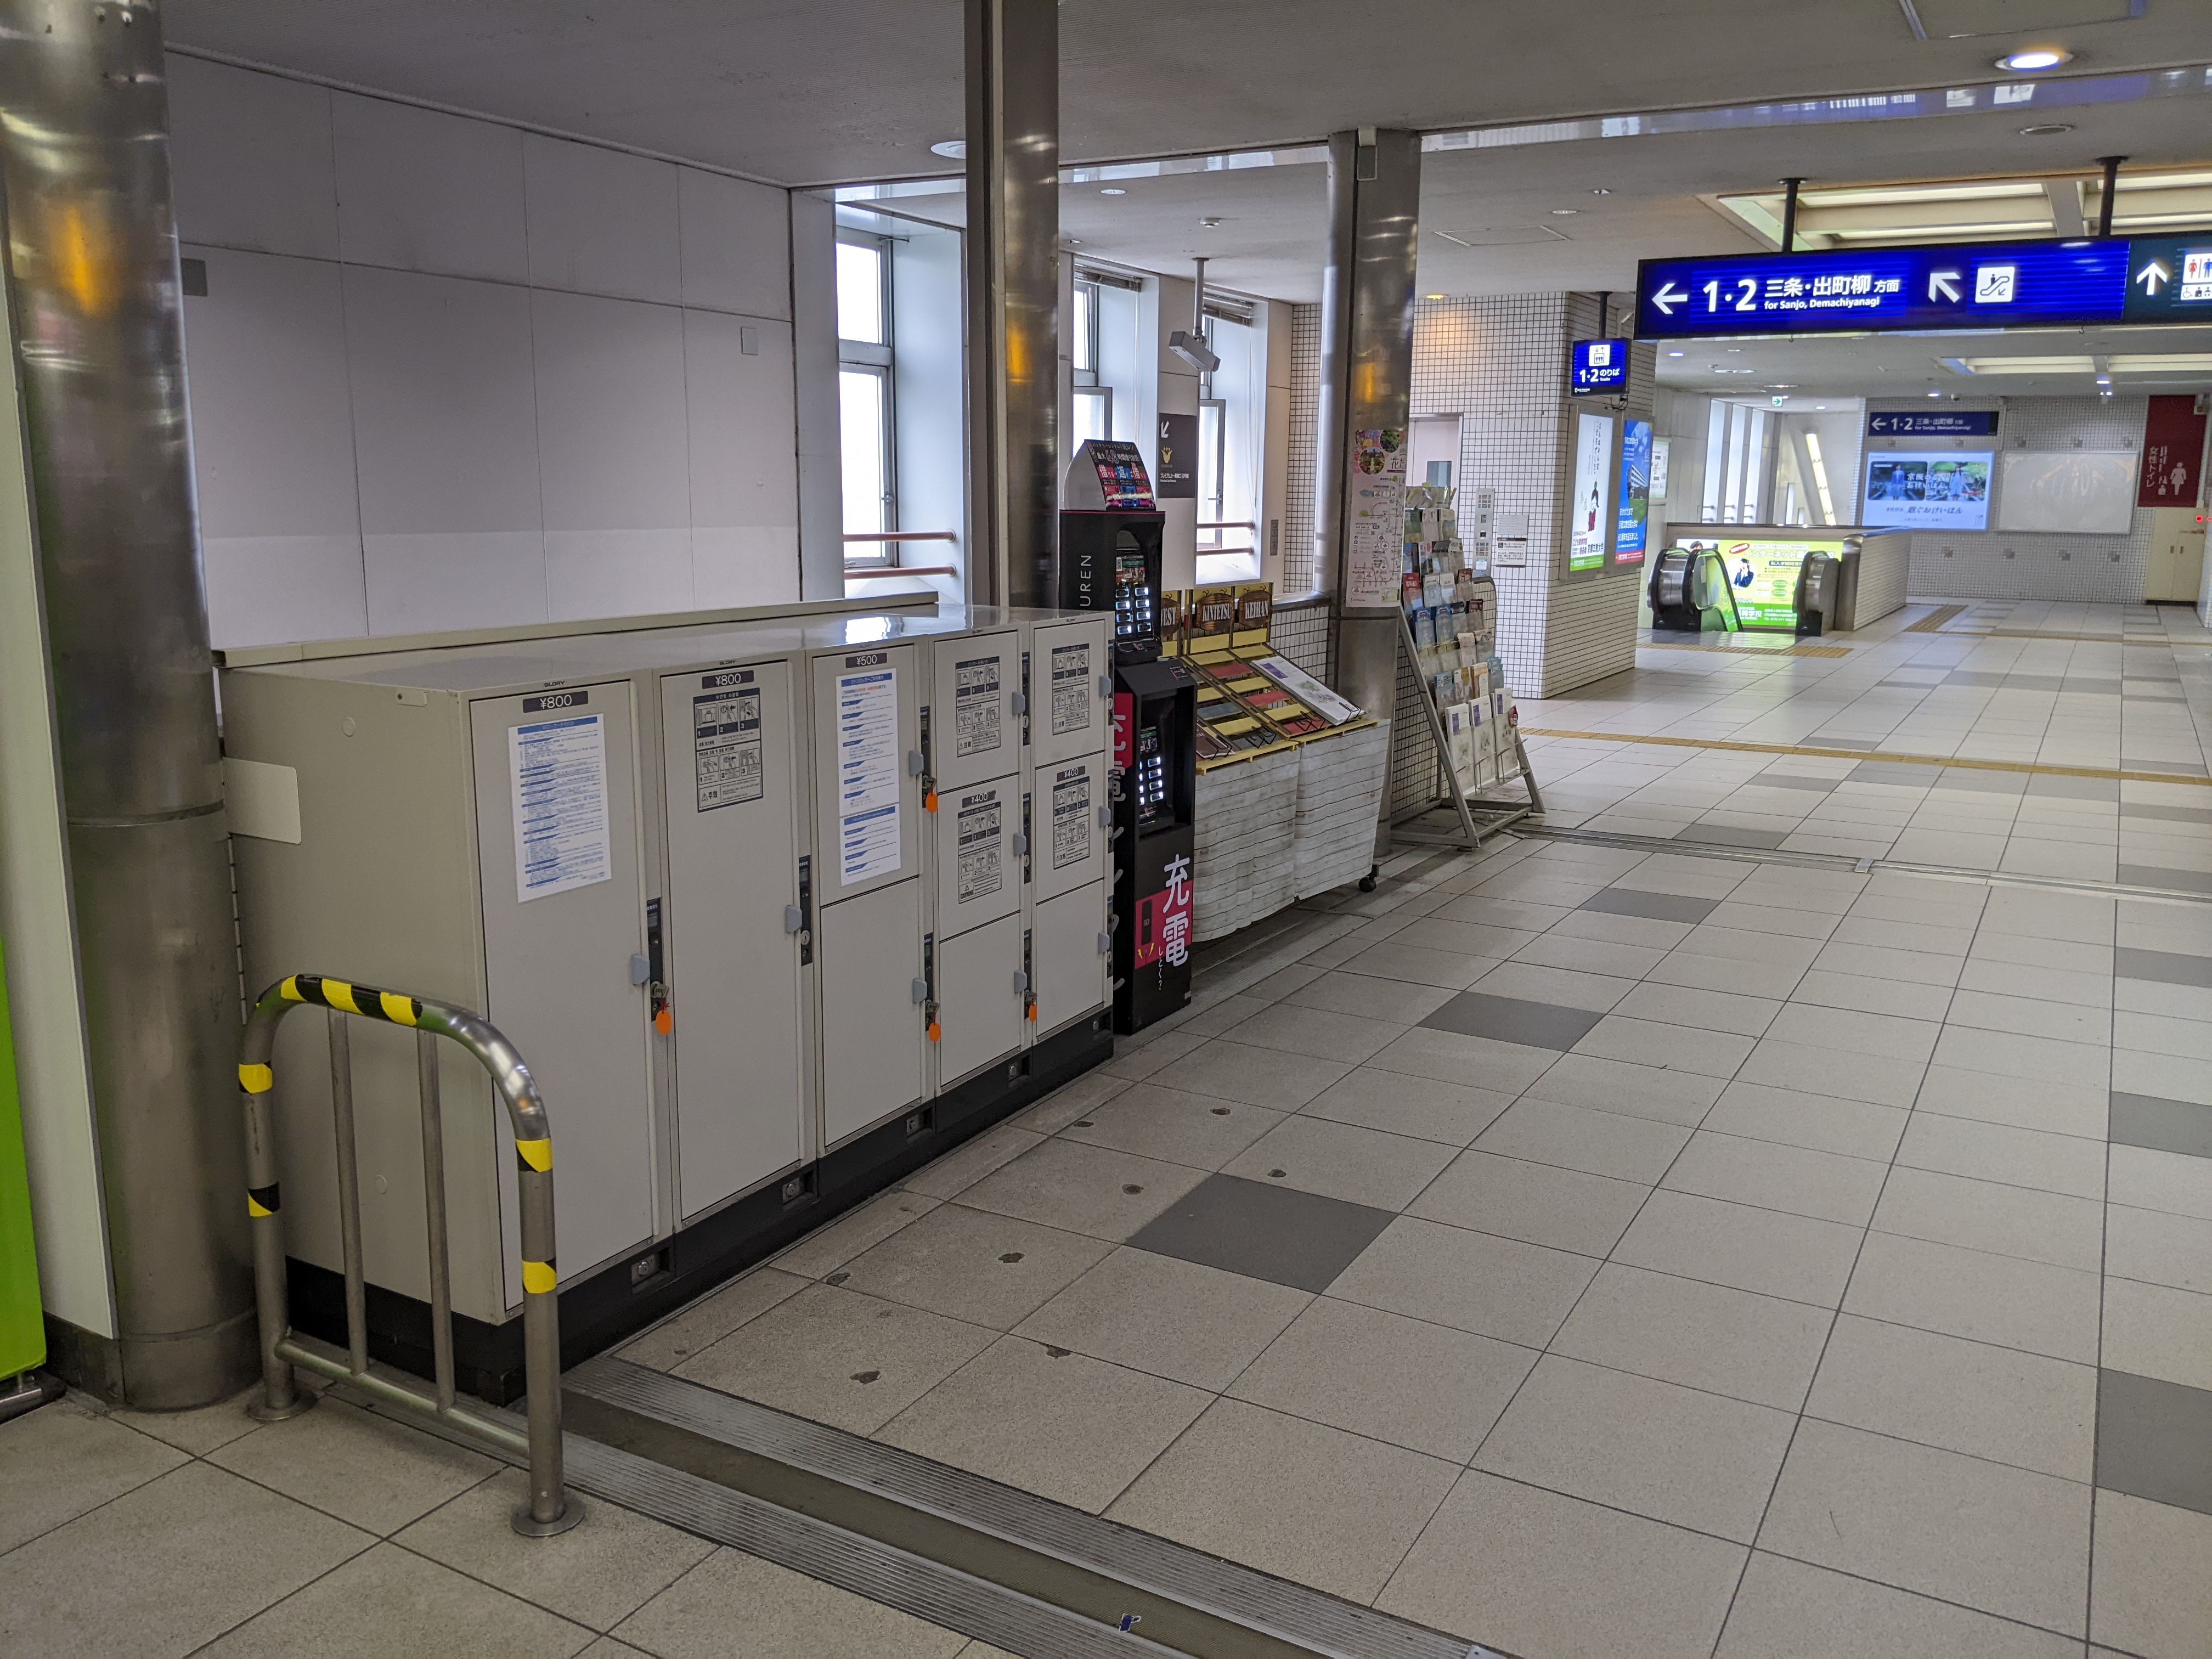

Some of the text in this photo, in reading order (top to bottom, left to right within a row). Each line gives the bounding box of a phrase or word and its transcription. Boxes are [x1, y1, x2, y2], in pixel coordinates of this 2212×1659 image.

[1765, 275, 1871, 297] 三条・出町柳
[1874, 279, 1900, 292] 方面
[1764, 297, 1880, 311] for Sanjo, Demachiyanagi
[1600, 368, 1620, 376] のりば
[2146, 446, 2159, 487] 女性トイレ
[1080, 555, 1092, 607] UREN
[1203, 603, 1232, 621] KINTETSU
[1245, 600, 1269, 619] KEIHAN
[856, 654, 877, 665] ¥500
[715, 674, 741, 686] ¥800
[540, 695, 572, 709] ¥800
[1064, 768, 1079, 778] ¥400
[972, 793, 988, 804] ¥400
[1163, 854, 1190, 967] 充電
